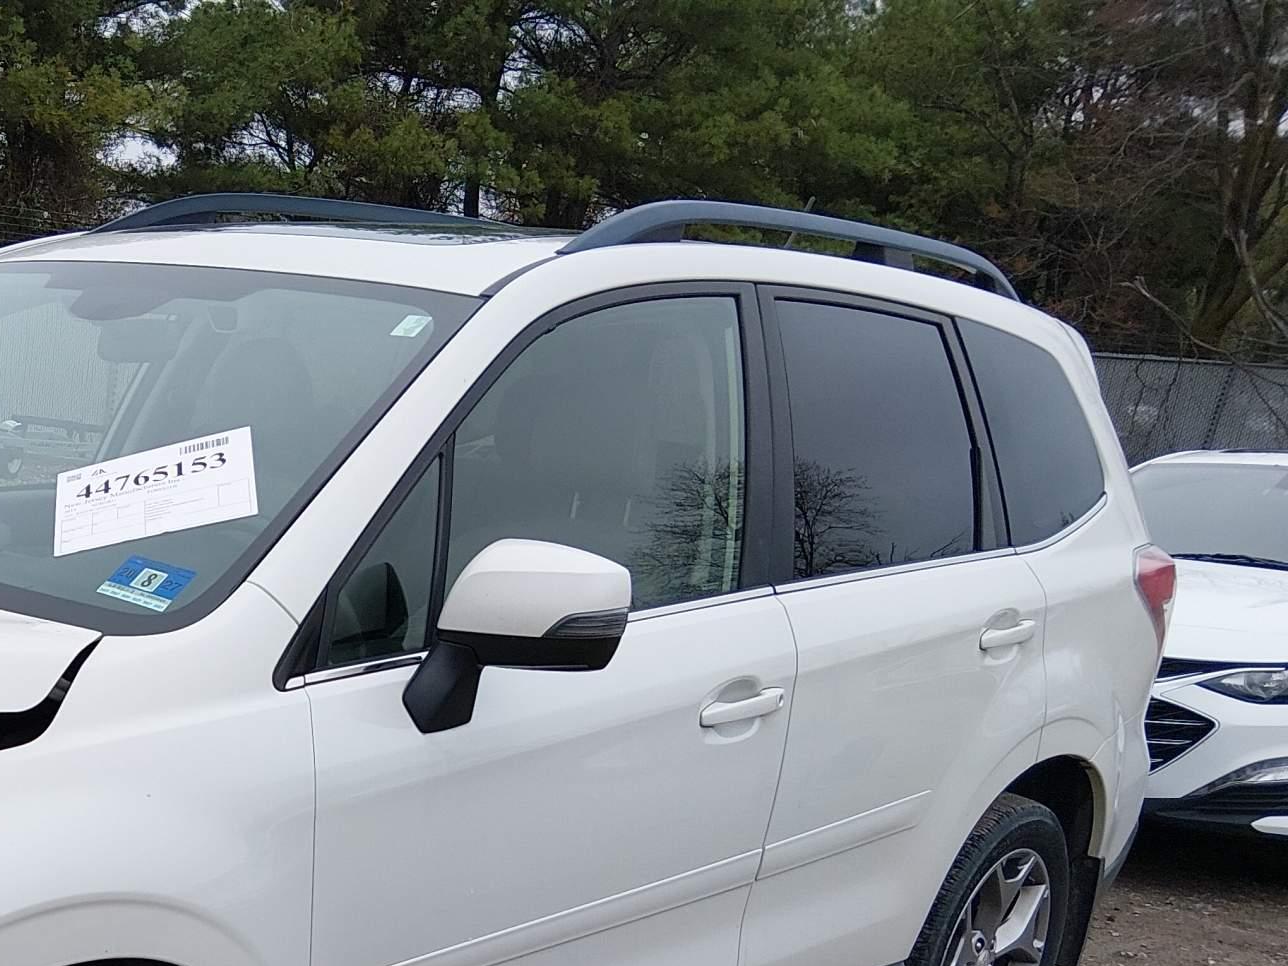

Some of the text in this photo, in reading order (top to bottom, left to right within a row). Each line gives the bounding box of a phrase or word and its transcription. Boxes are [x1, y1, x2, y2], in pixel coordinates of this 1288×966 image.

[75, 452, 227, 499] 44765153
[140, 572, 159, 588] 8
[160, 580, 183, 592] 27
